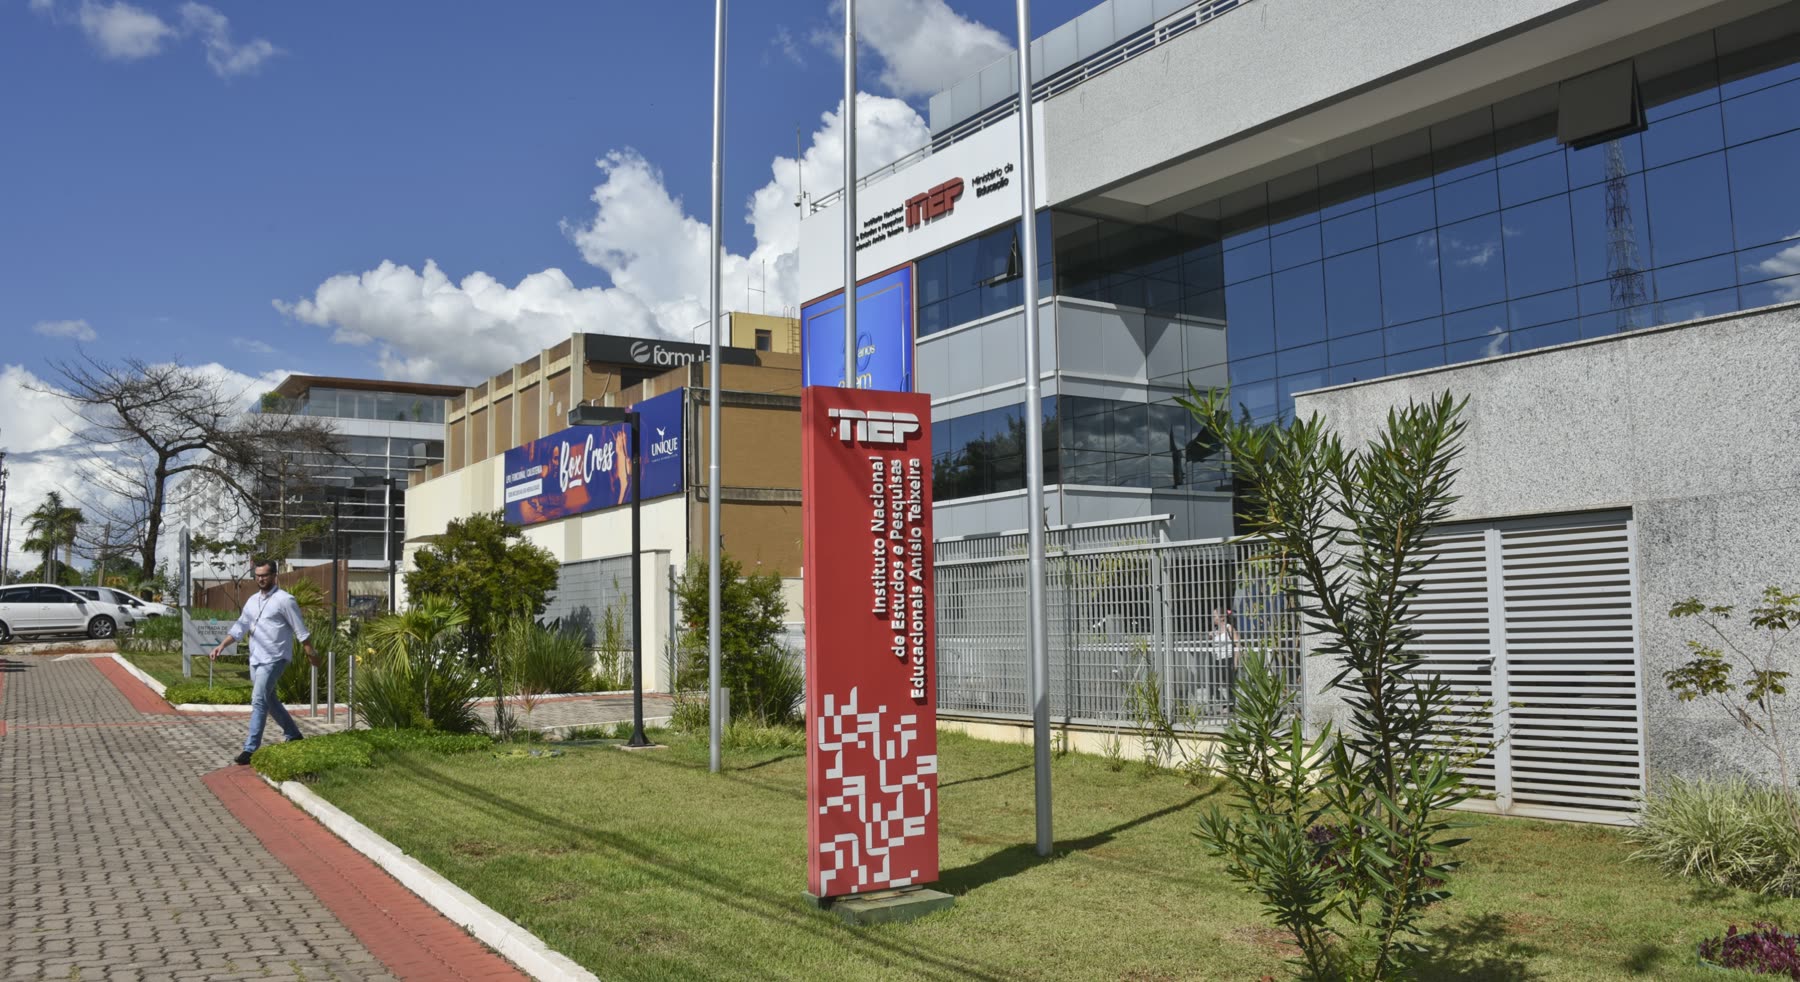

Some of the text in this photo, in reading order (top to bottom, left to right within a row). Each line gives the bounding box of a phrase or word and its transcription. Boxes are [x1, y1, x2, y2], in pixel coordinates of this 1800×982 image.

[972, 163, 1013, 188] Ministério da
[976, 177, 1009, 198] Educação
[864, 203, 904, 228] Instituto Nacional
[653, 345, 710, 366] fórmul
[651, 437, 678, 456] UNIQUE
[560, 434, 615, 492] Box Cross
[868, 456, 886, 613] Instituto Nacional
[888, 459, 906, 657] de Estudos e Pesquisas
[907, 458, 925, 698] Educacionais Anísio Teixeira
